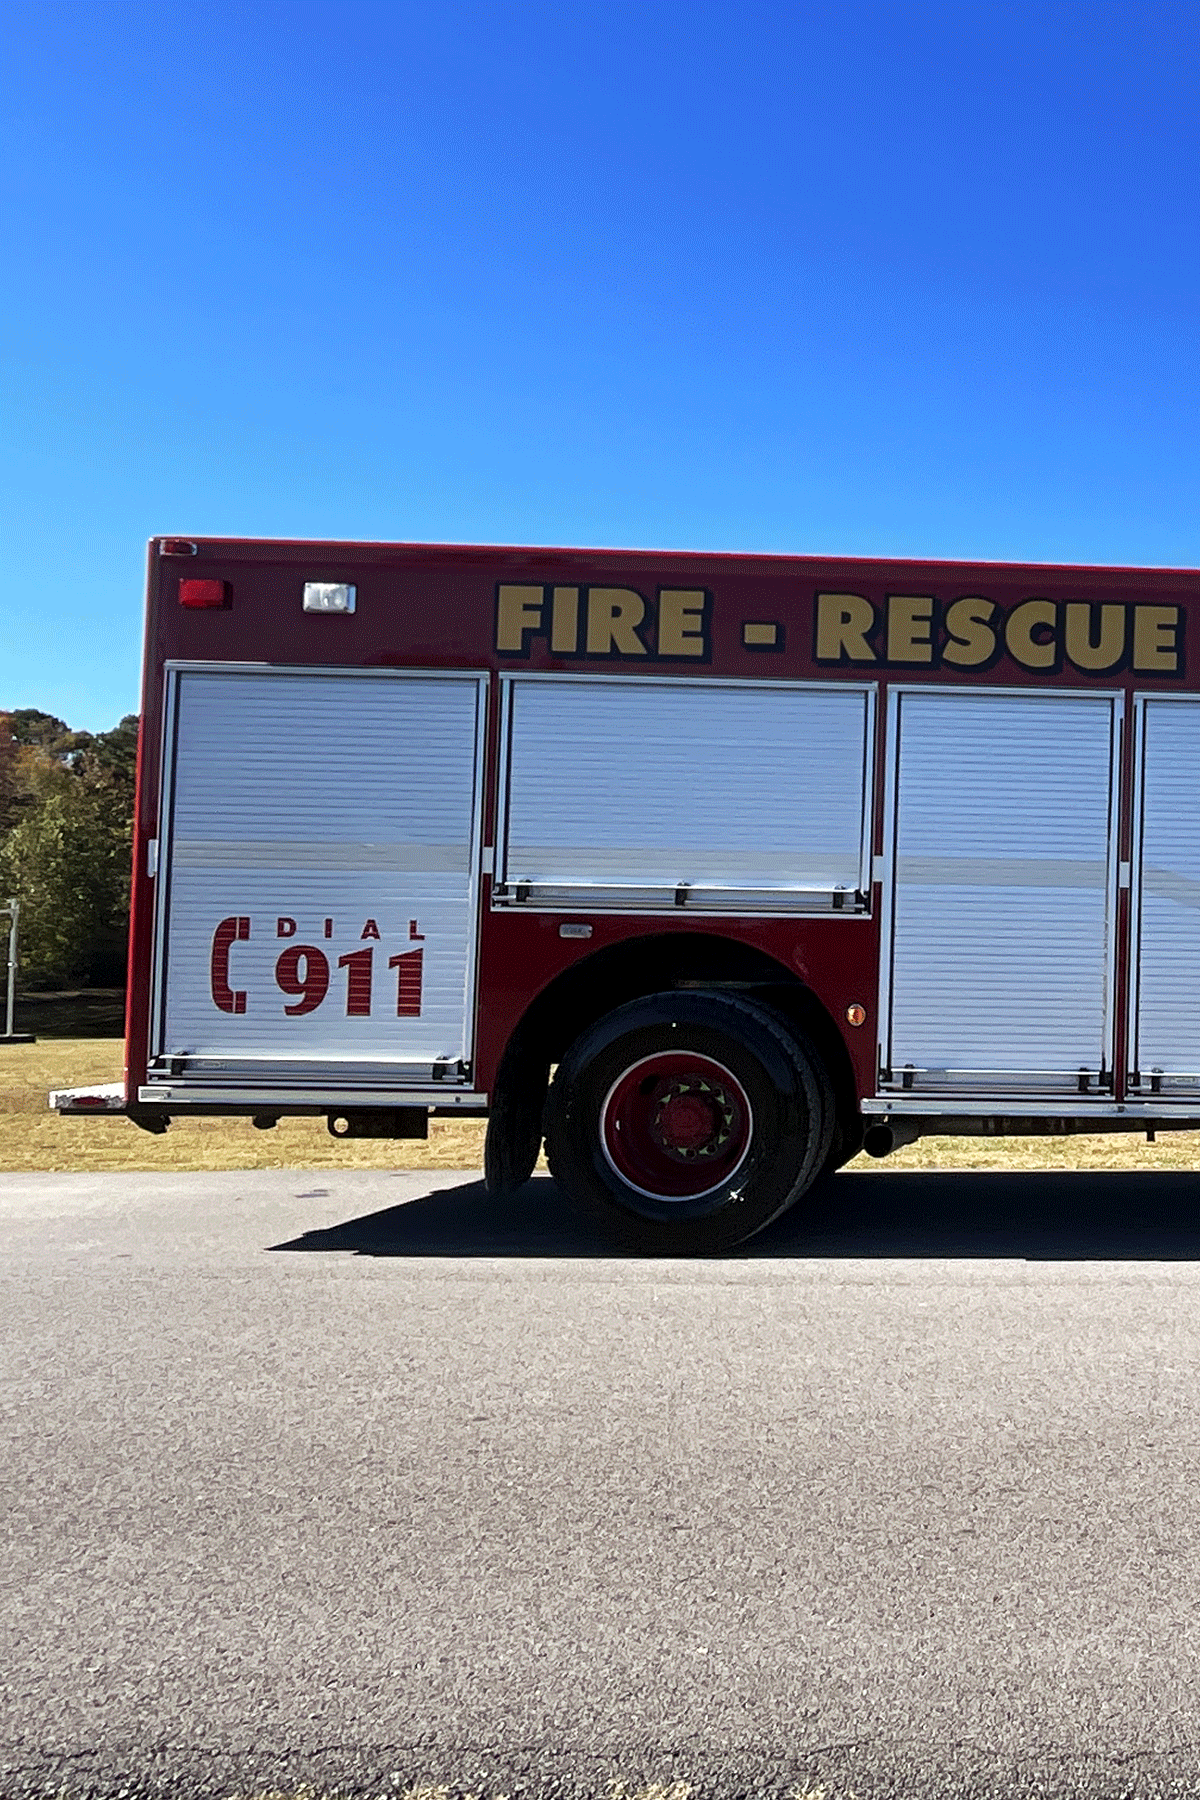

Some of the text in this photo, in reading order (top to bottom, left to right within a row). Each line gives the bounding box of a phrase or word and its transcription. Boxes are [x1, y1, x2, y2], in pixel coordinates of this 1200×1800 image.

[496, 584, 1180, 671] FIRE - RESCUE
[276, 916, 426, 941] DIAL
[275, 944, 425, 1018] 911
